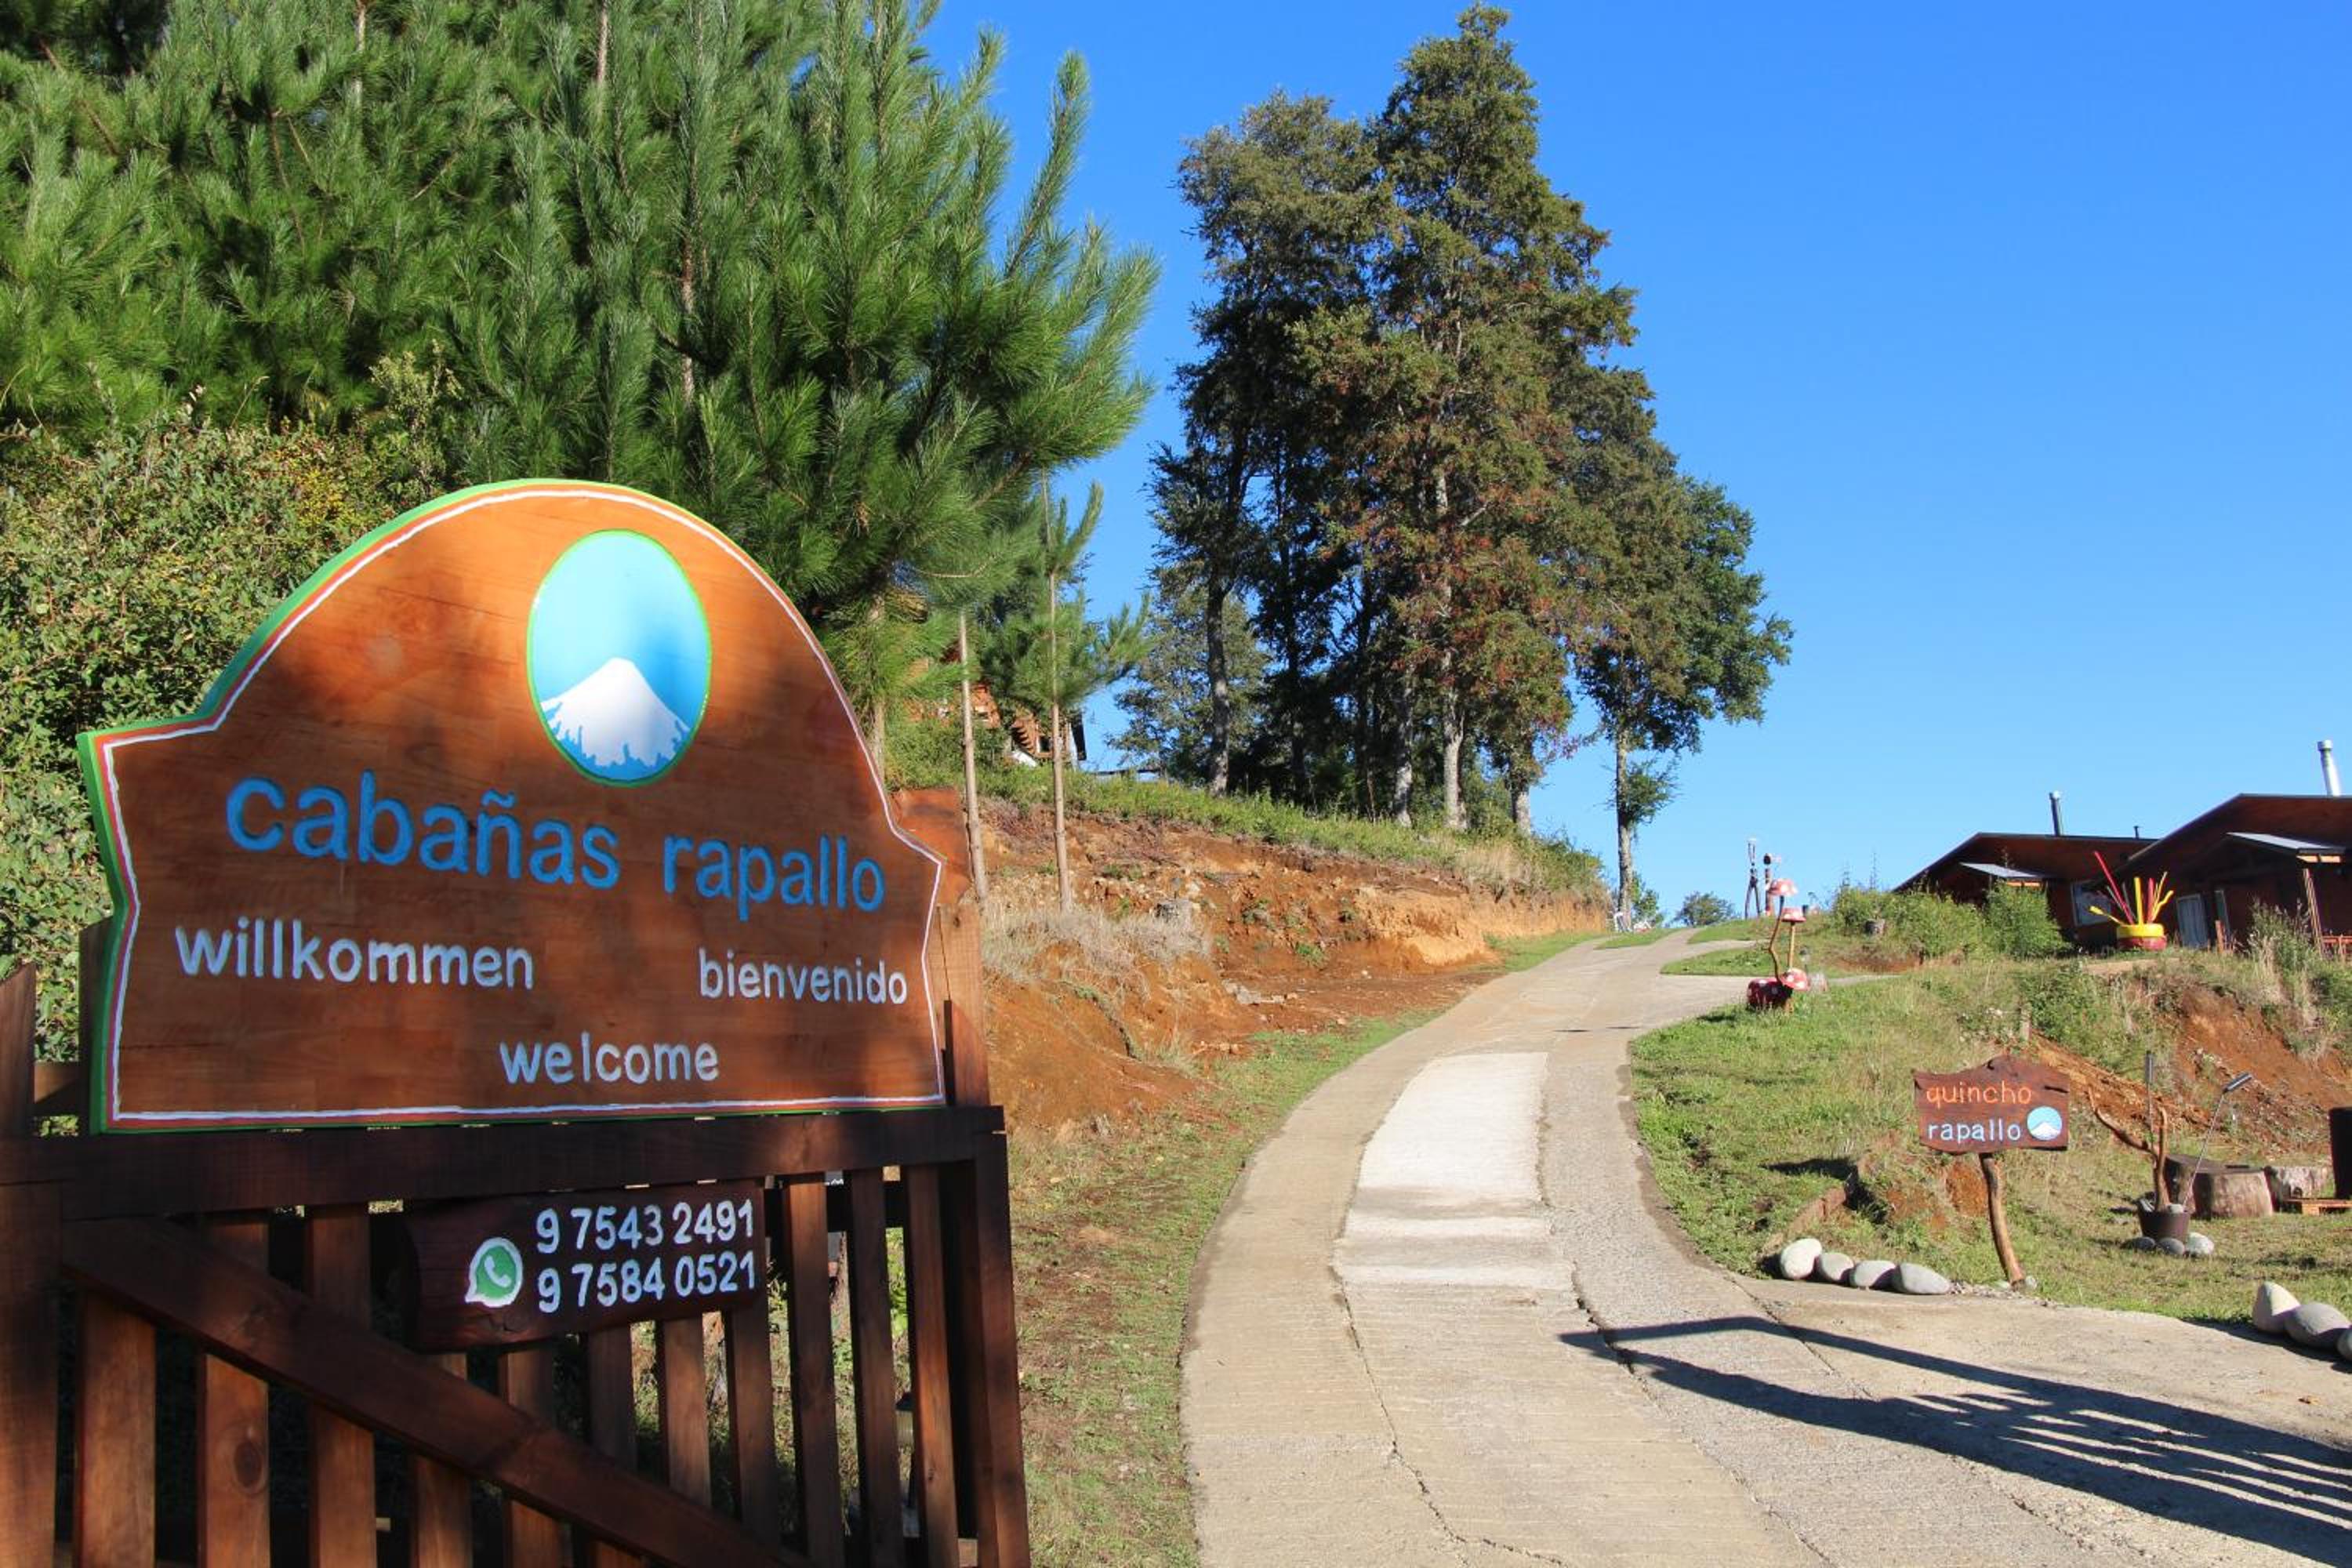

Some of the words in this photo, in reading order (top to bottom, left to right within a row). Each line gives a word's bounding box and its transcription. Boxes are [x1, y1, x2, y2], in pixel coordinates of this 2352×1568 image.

[663, 833, 885, 922] rapallo
[175, 916, 533, 990] willkommen
[699, 948, 908, 1005] bienvenido
[500, 1031, 720, 1085] welcome
[1926, 1080, 2032, 1109] quincho
[1928, 1118, 2021, 1143] rapallo
[536, 1207, 561, 1254] 9
[570, 1204, 664, 1251] 7543
[672, 1198, 754, 1245] 2491
[537, 1268, 561, 1313] 9
[571, 1257, 666, 1308] 7584
[675, 1250, 755, 1298] 0521
